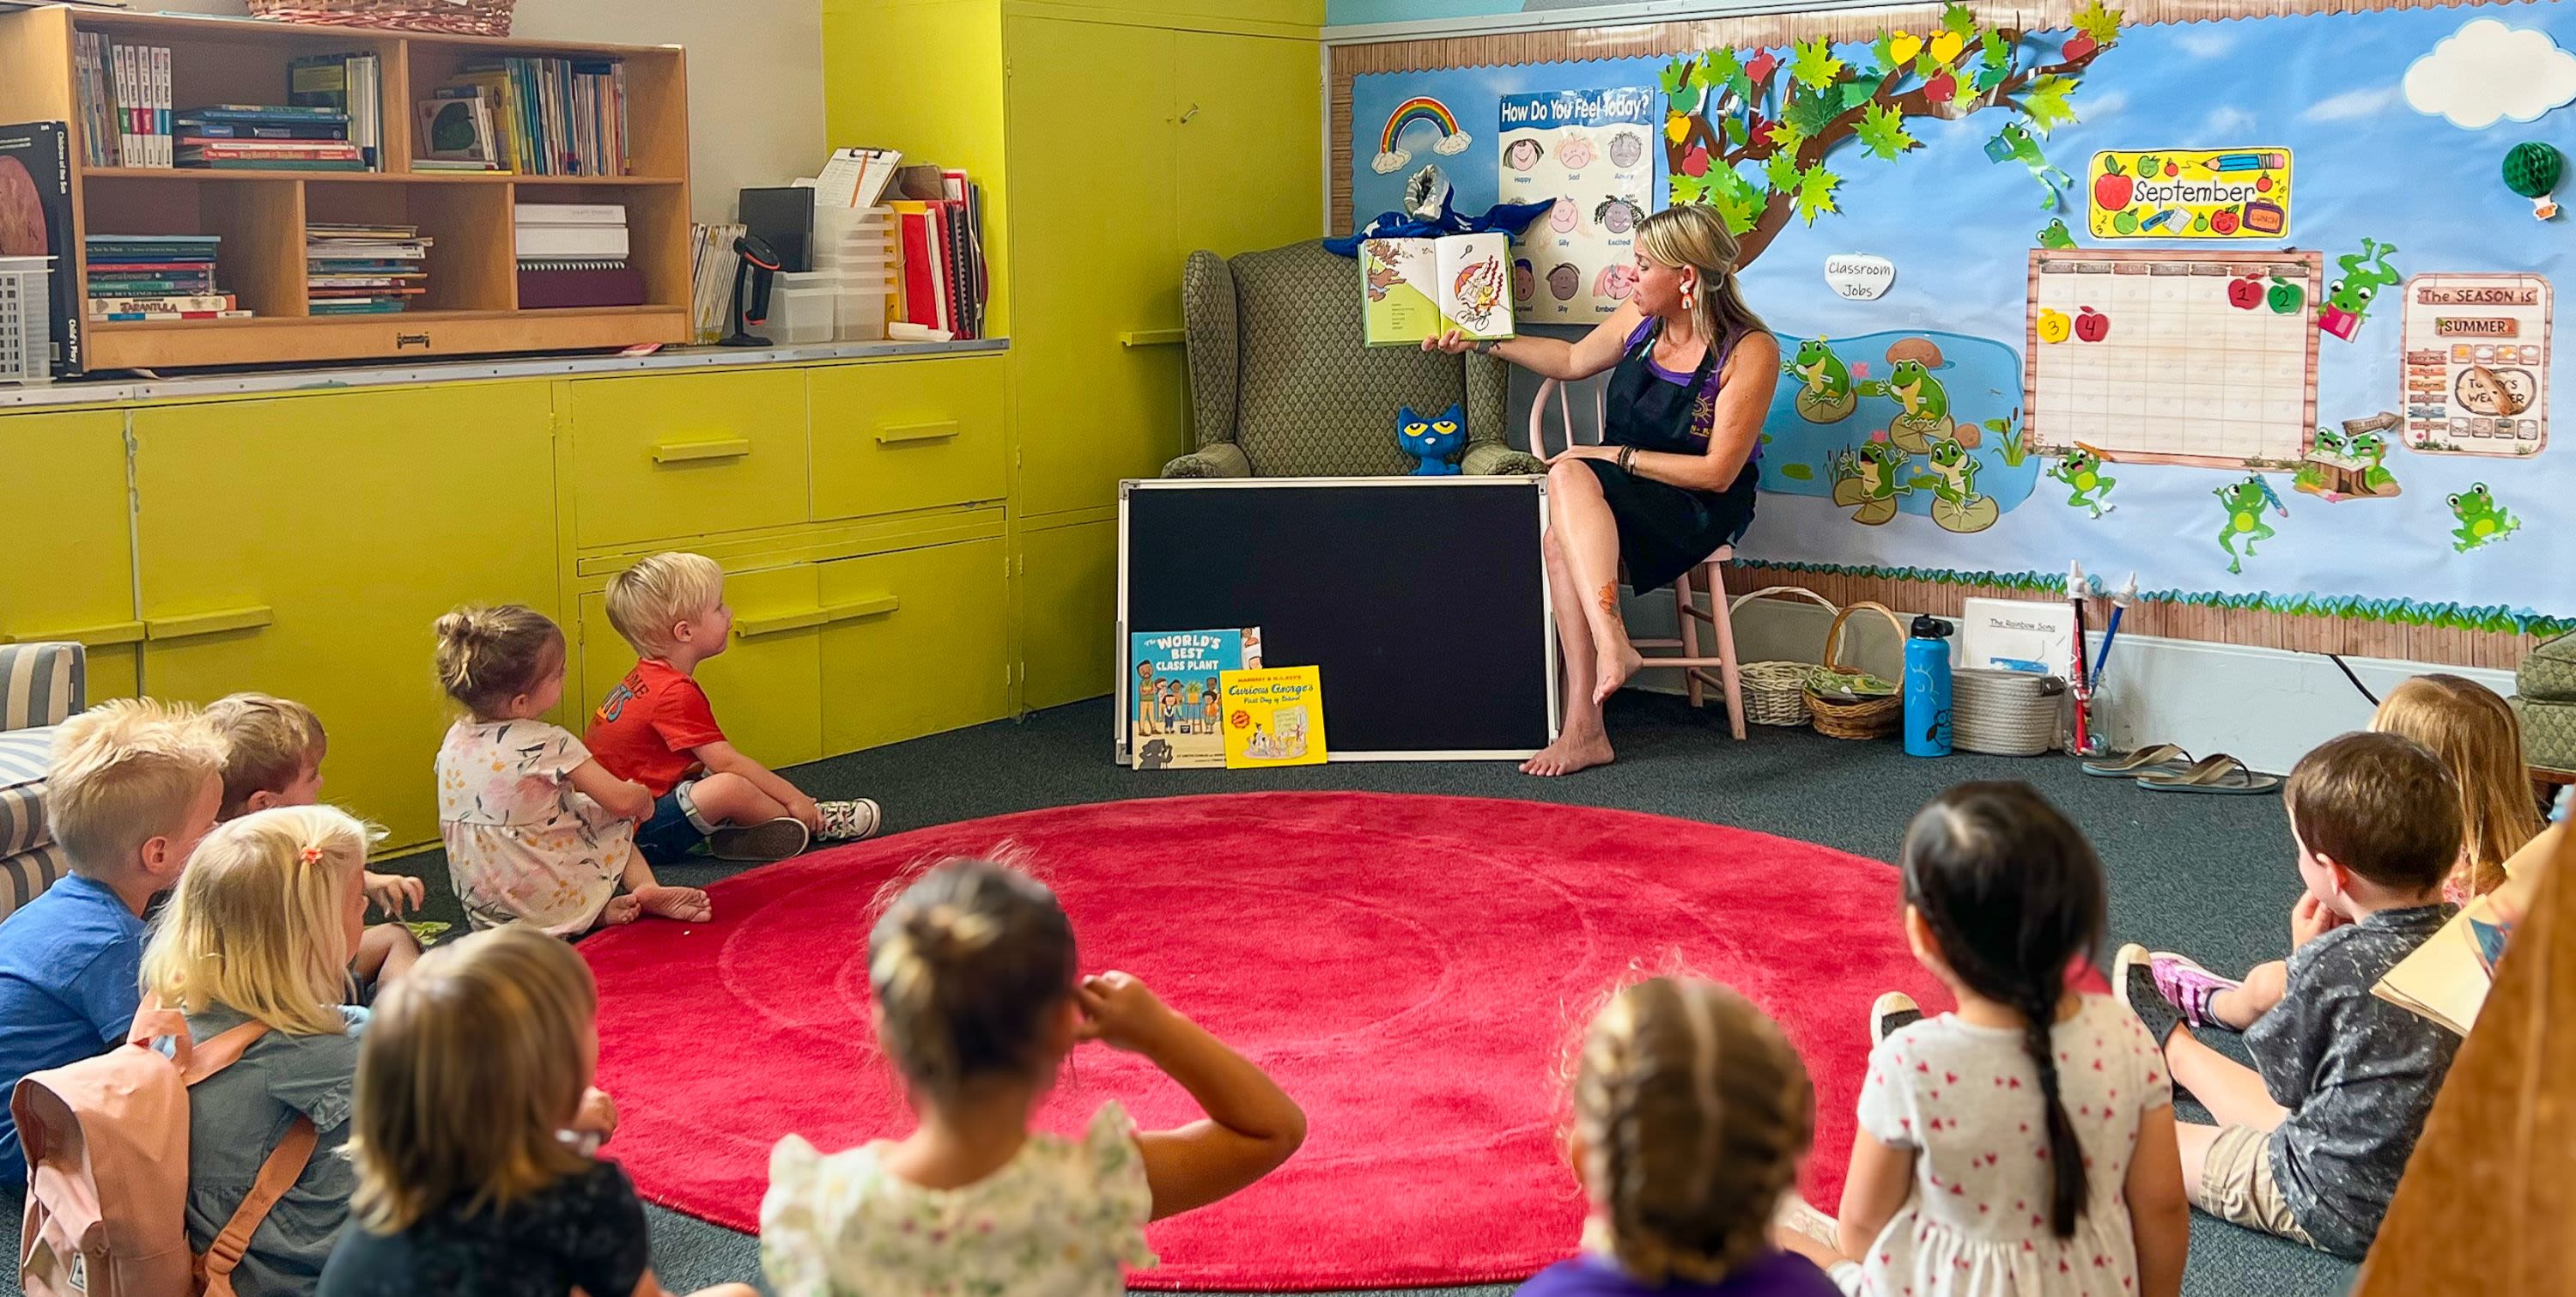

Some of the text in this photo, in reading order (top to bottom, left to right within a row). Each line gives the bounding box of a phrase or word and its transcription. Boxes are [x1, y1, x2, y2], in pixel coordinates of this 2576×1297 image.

[1502, 94, 1649, 122] How Do You Feel Today?
[2135, 179, 2256, 209] September
[2251, 215, 2279, 224] LUNCH
[1558, 239, 1571, 247] Silly
[1829, 262, 1891, 275] Classroom
[1843, 283, 1873, 297] Jobs
[2237, 287, 2250, 301] 1
[2424, 289, 2531, 302] The SEASON is
[2277, 289, 2290, 308] 2
[119, 302, 178, 313] TARANTULA
[1558, 305, 1569, 314] Shy
[2048, 320, 2060, 336] 3
[2085, 318, 2096, 337] 4
[2445, 320, 2506, 333] SUMMER
[2469, 393, 2524, 404] WEAER
[2005, 619, 2035, 629] Rainbow
[2038, 623, 2056, 632] Song
[1157, 634, 1222, 650] WORLD'S
[1171, 648, 1205, 660] BEST
[1156, 660, 1219, 671] CLASS PLANT
[1229, 683, 1314, 696] Curious George's
[1260, 696, 1272, 704] Day
